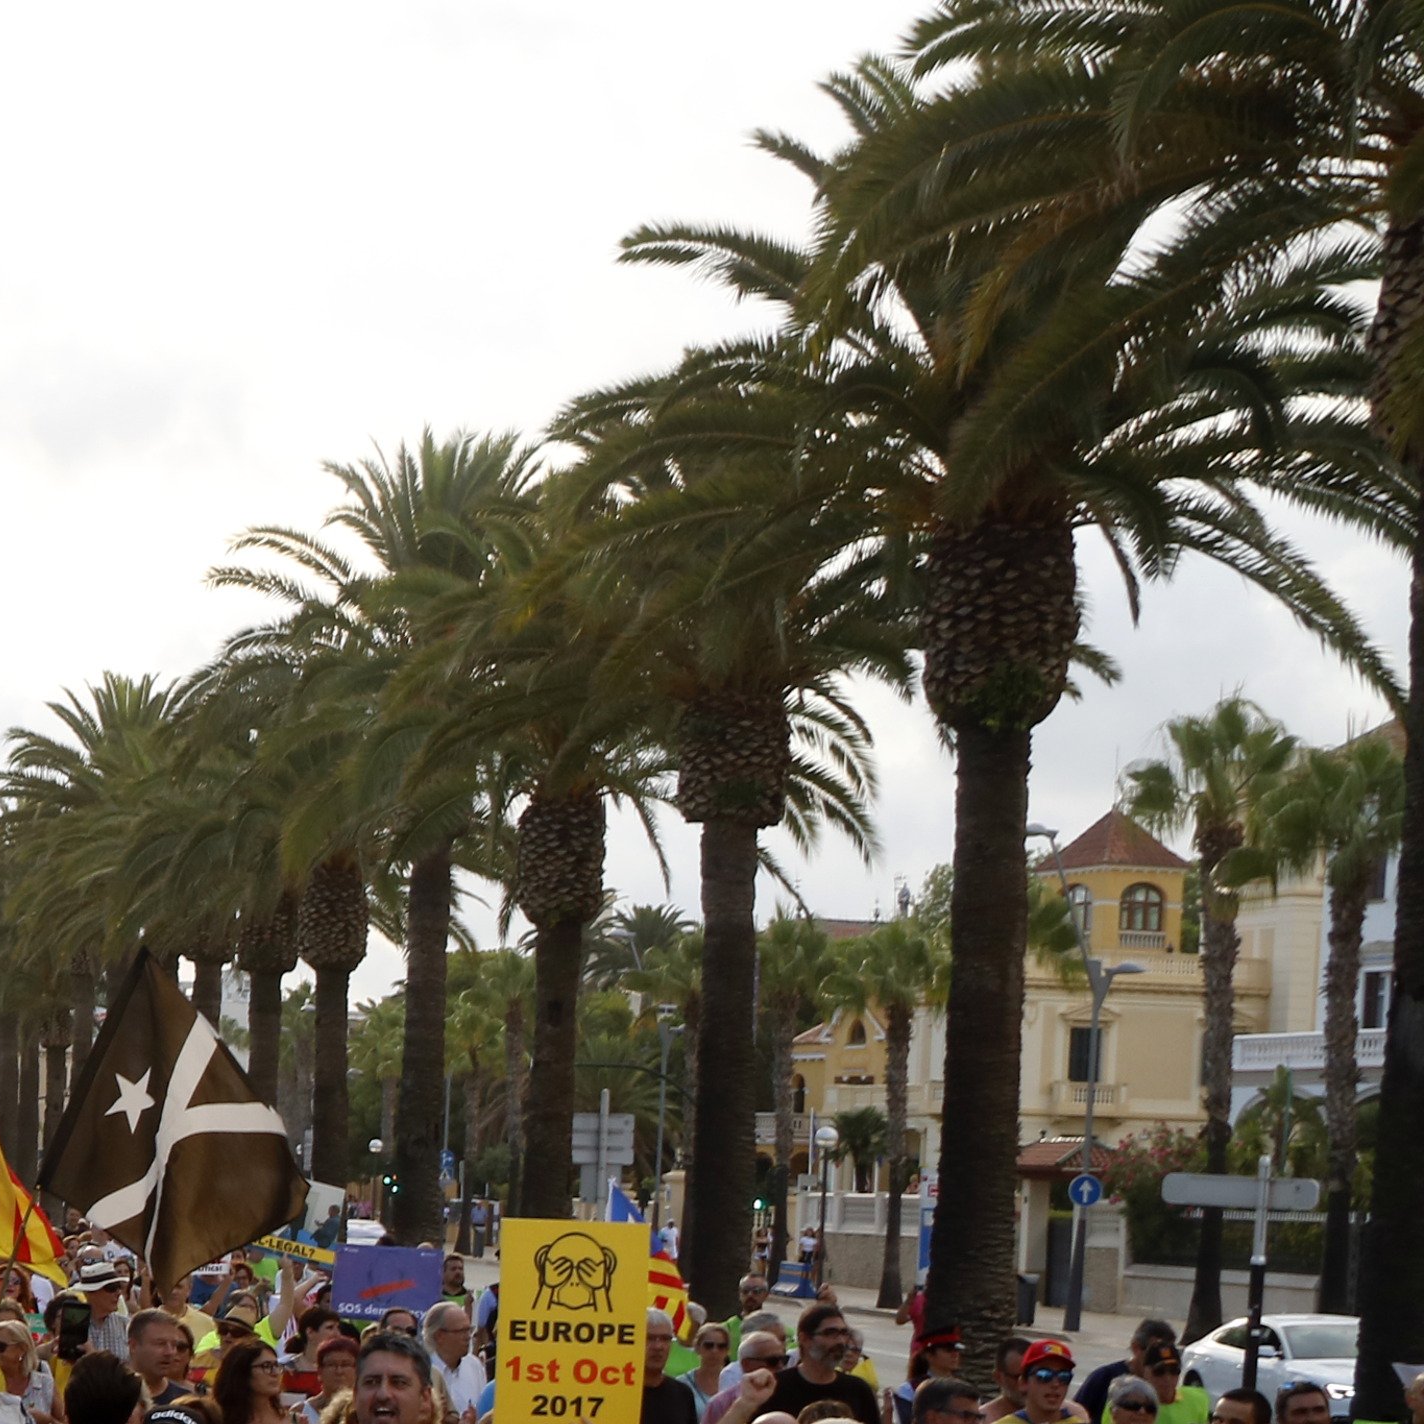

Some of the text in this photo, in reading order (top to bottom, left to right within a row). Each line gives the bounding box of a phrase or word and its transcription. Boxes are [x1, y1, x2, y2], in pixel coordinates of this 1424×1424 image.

[253, 1236, 316, 1259] L·LEGAL?
[338, 1302, 427, 1321] SOS demcy
[509, 1320, 636, 1345] EUROPE
[505, 1356, 637, 1387] 1st Oct
[531, 1394, 605, 1418] 2017
